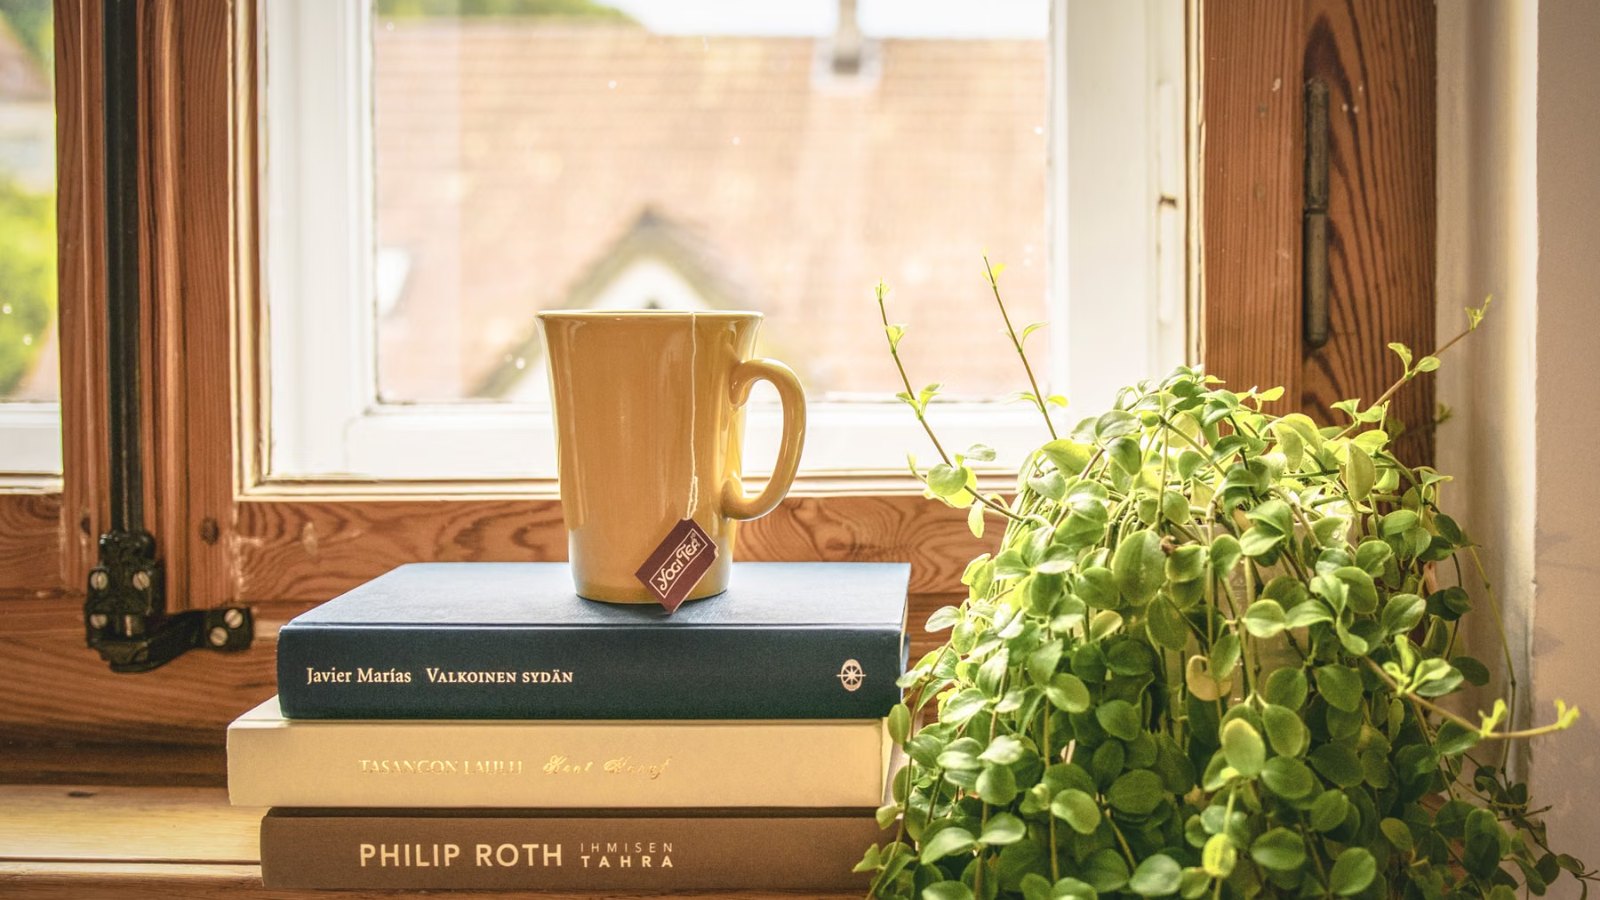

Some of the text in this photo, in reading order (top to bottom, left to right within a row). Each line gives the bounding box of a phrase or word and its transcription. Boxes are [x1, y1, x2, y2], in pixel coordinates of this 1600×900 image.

[306, 666, 411, 685] Javier Marías
[426, 667, 573, 683] VALKOINEN SYDÄN
[359, 843, 563, 867] PHILIP ROTH
[580, 842, 673, 853] IHMISEN
[580, 855, 673, 868] TAHRA
